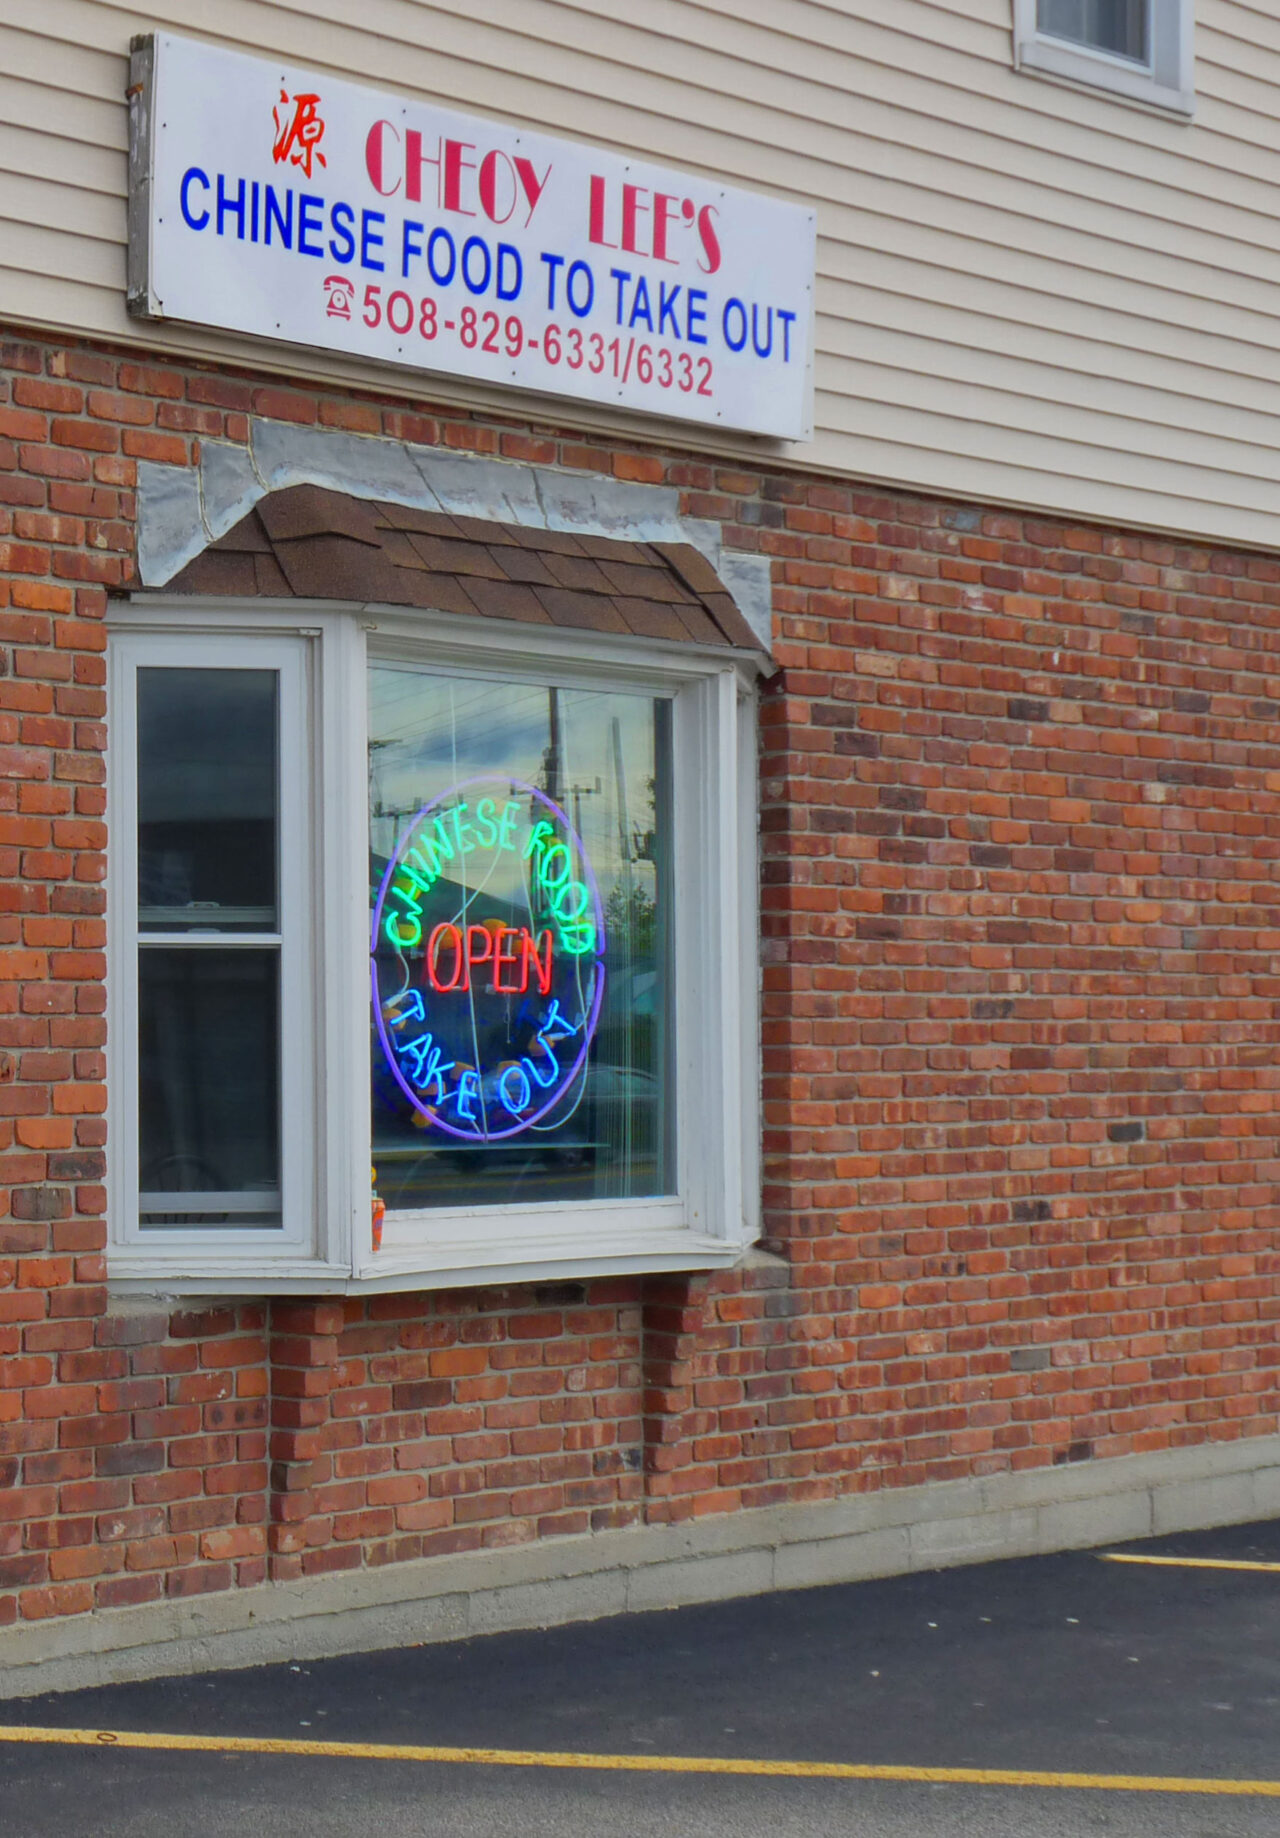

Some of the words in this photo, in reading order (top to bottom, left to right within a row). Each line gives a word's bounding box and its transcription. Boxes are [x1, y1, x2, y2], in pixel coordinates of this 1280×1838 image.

[272, 88, 328, 180] 源
[365, 119, 553, 229] CHEOY
[588, 174, 721, 275] LEE'S
[180, 166, 386, 273] CHINESE
[402, 218, 523, 302] FOOD
[540, 252, 595, 319] TO
[610, 267, 708, 346] TAKE
[722, 297, 797, 364] OUT
[362, 284, 714, 398] 508-829-6331/6332
[385, 797, 522, 947] CHINESE
[522, 820, 597, 954] FOOD
[427, 922, 553, 996] OPEN
[389, 988, 481, 1122] TAKE
[499, 999, 578, 1114] OUT
